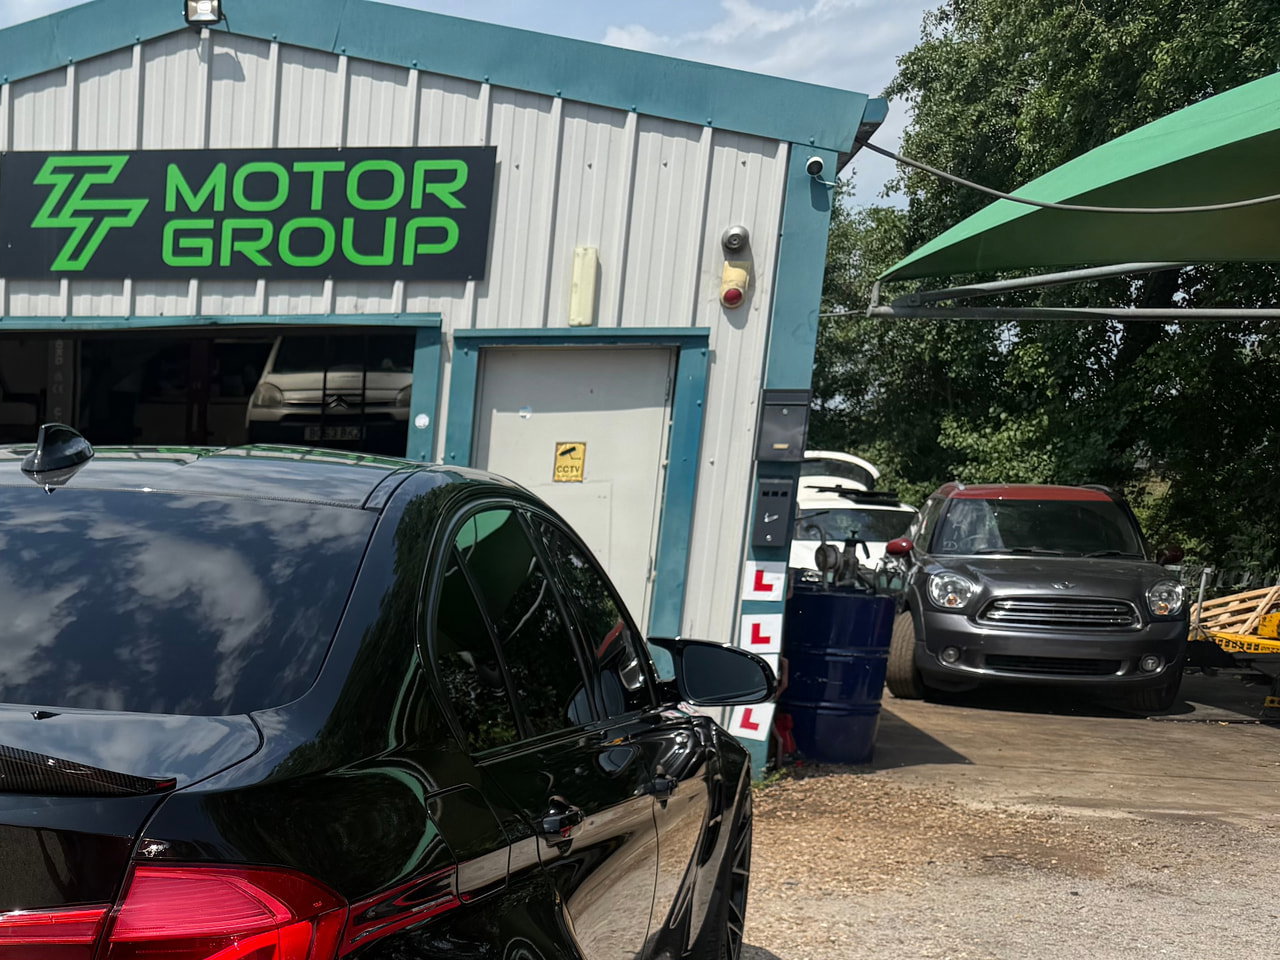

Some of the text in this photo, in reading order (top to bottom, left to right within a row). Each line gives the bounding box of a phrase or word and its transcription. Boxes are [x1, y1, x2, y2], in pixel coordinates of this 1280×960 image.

[164, 159, 469, 212] MOTOR
[161, 216, 460, 267] GROUP
[556, 465, 580, 474] CCTV
[753, 570, 773, 592] L
[751, 623, 771, 644] L
[739, 707, 760, 731] L
